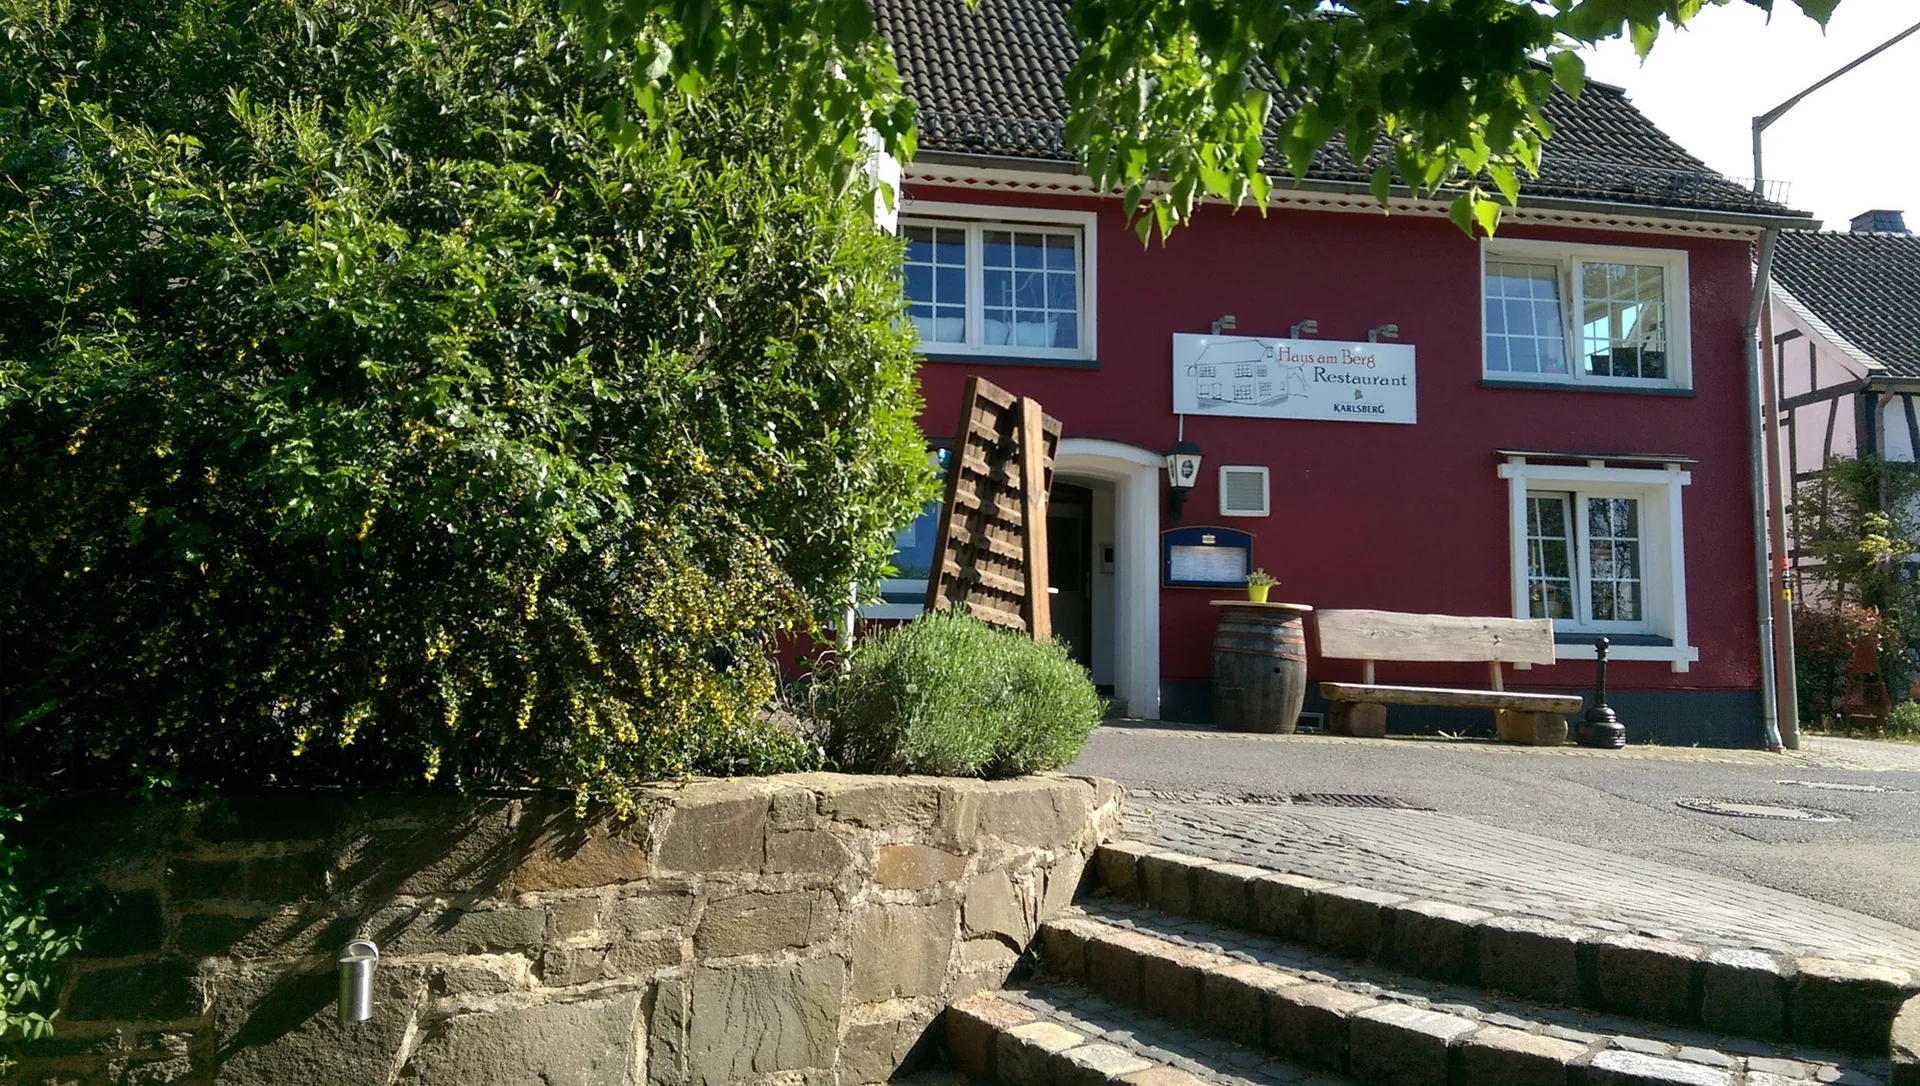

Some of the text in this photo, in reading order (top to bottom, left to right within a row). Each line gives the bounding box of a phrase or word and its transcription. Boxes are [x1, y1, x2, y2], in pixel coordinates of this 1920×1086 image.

[1278, 347, 1376, 369] Haus am Berg
[1313, 366, 1407, 386] Restaurant
[1333, 403, 1385, 414] KARLSBERG
